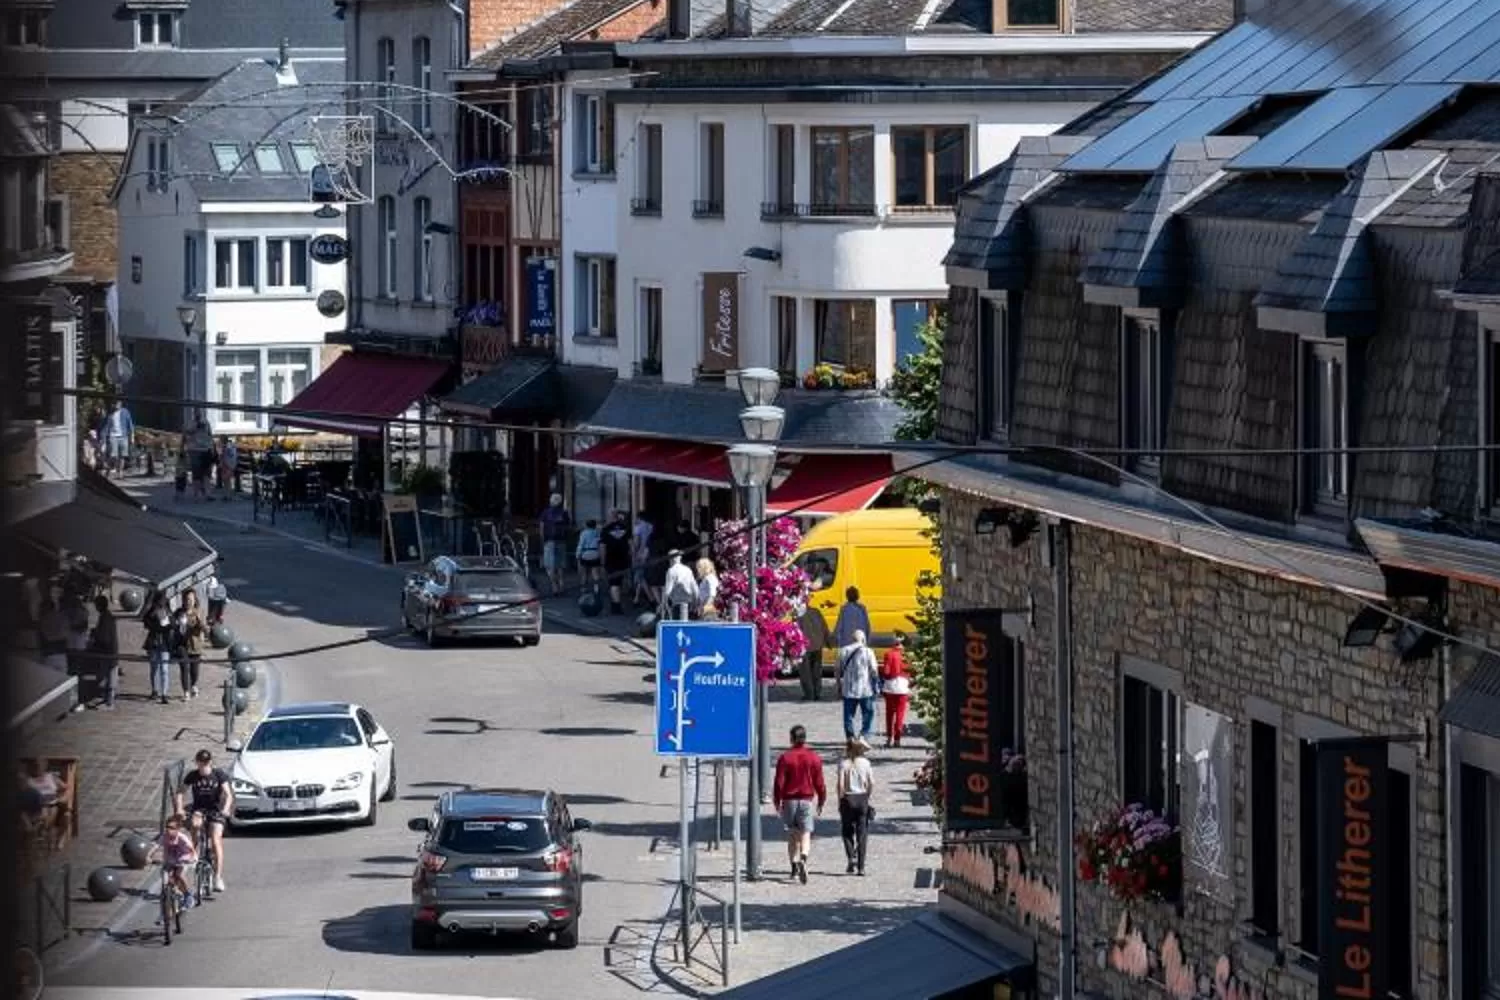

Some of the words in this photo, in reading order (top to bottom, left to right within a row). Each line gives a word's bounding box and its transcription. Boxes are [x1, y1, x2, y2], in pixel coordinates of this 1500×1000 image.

[693, 672, 746, 687] Houffalize
[960, 622, 989, 763] Litherer
[960, 772, 989, 816] Le
[1336, 755, 1371, 932] Litherer
[1336, 944, 1371, 999] Le
